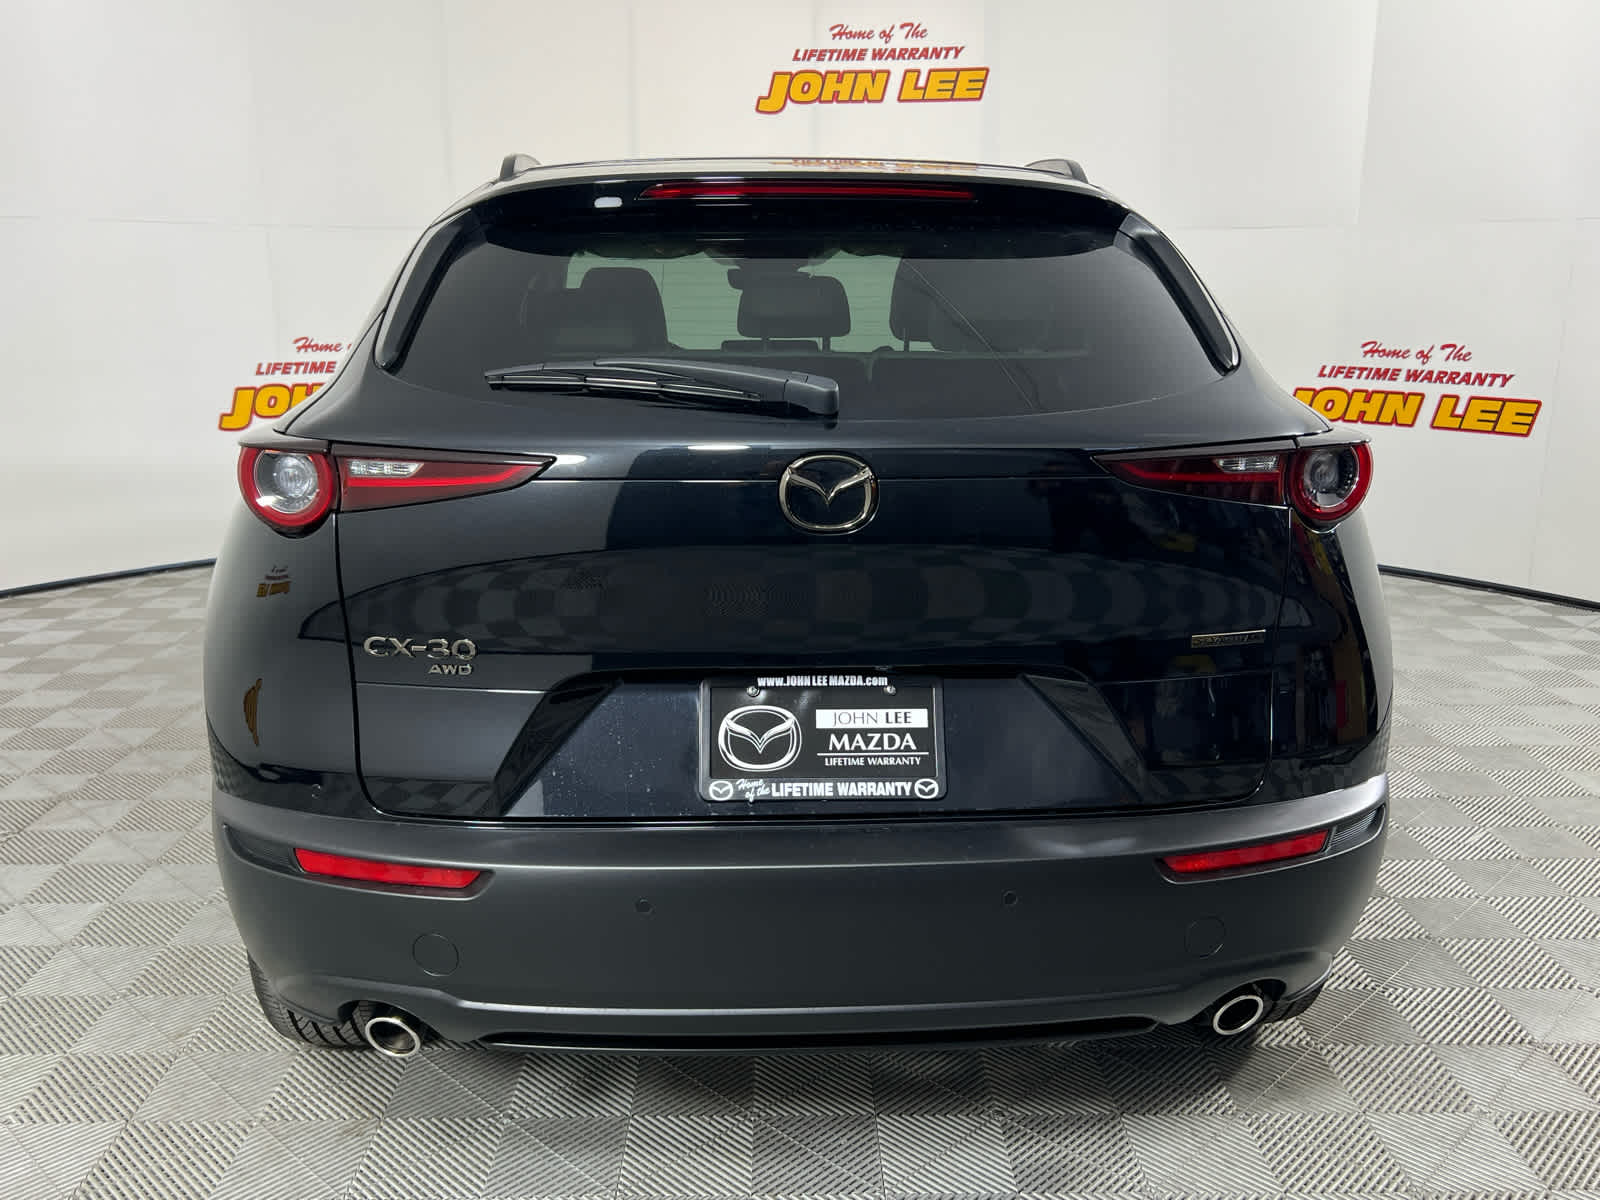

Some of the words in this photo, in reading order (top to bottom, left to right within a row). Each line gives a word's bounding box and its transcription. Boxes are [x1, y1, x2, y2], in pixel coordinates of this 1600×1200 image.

[829, 23, 874, 41] Home
[879, 26, 895, 44] of
[899, 22, 928, 40] The
[792, 48, 869, 62] LIFETIME
[871, 46, 965, 61] WARRANTY
[755, 69, 891, 115] JOHN
[897, 66, 990, 103] LEE
[293, 336, 343, 353] Home
[1360, 340, 1411, 360] Home
[1415, 344, 1435, 365] of
[1440, 343, 1473, 362] The
[255, 360, 338, 376] LIFETIME
[1316, 364, 1402, 382] LIFETIME
[1404, 368, 1515, 388] WARRANTY
[218, 382, 326, 432] JOH
[1430, 394, 1542, 438] LEE
[363, 636, 476, 660] CX-30
[428, 663, 473, 676] AWD
[833, 711, 878, 726] JOHN
[885, 711, 913, 725] LEE
[828, 732, 917, 751] MAZDA
[824, 757, 865, 767] LIFETIME
[867, 756, 921, 766] WARRANTY
[736, 778, 764, 791] Home
[771, 782, 834, 797] LIFETIME
[837, 781, 913, 797] WARRANTY
